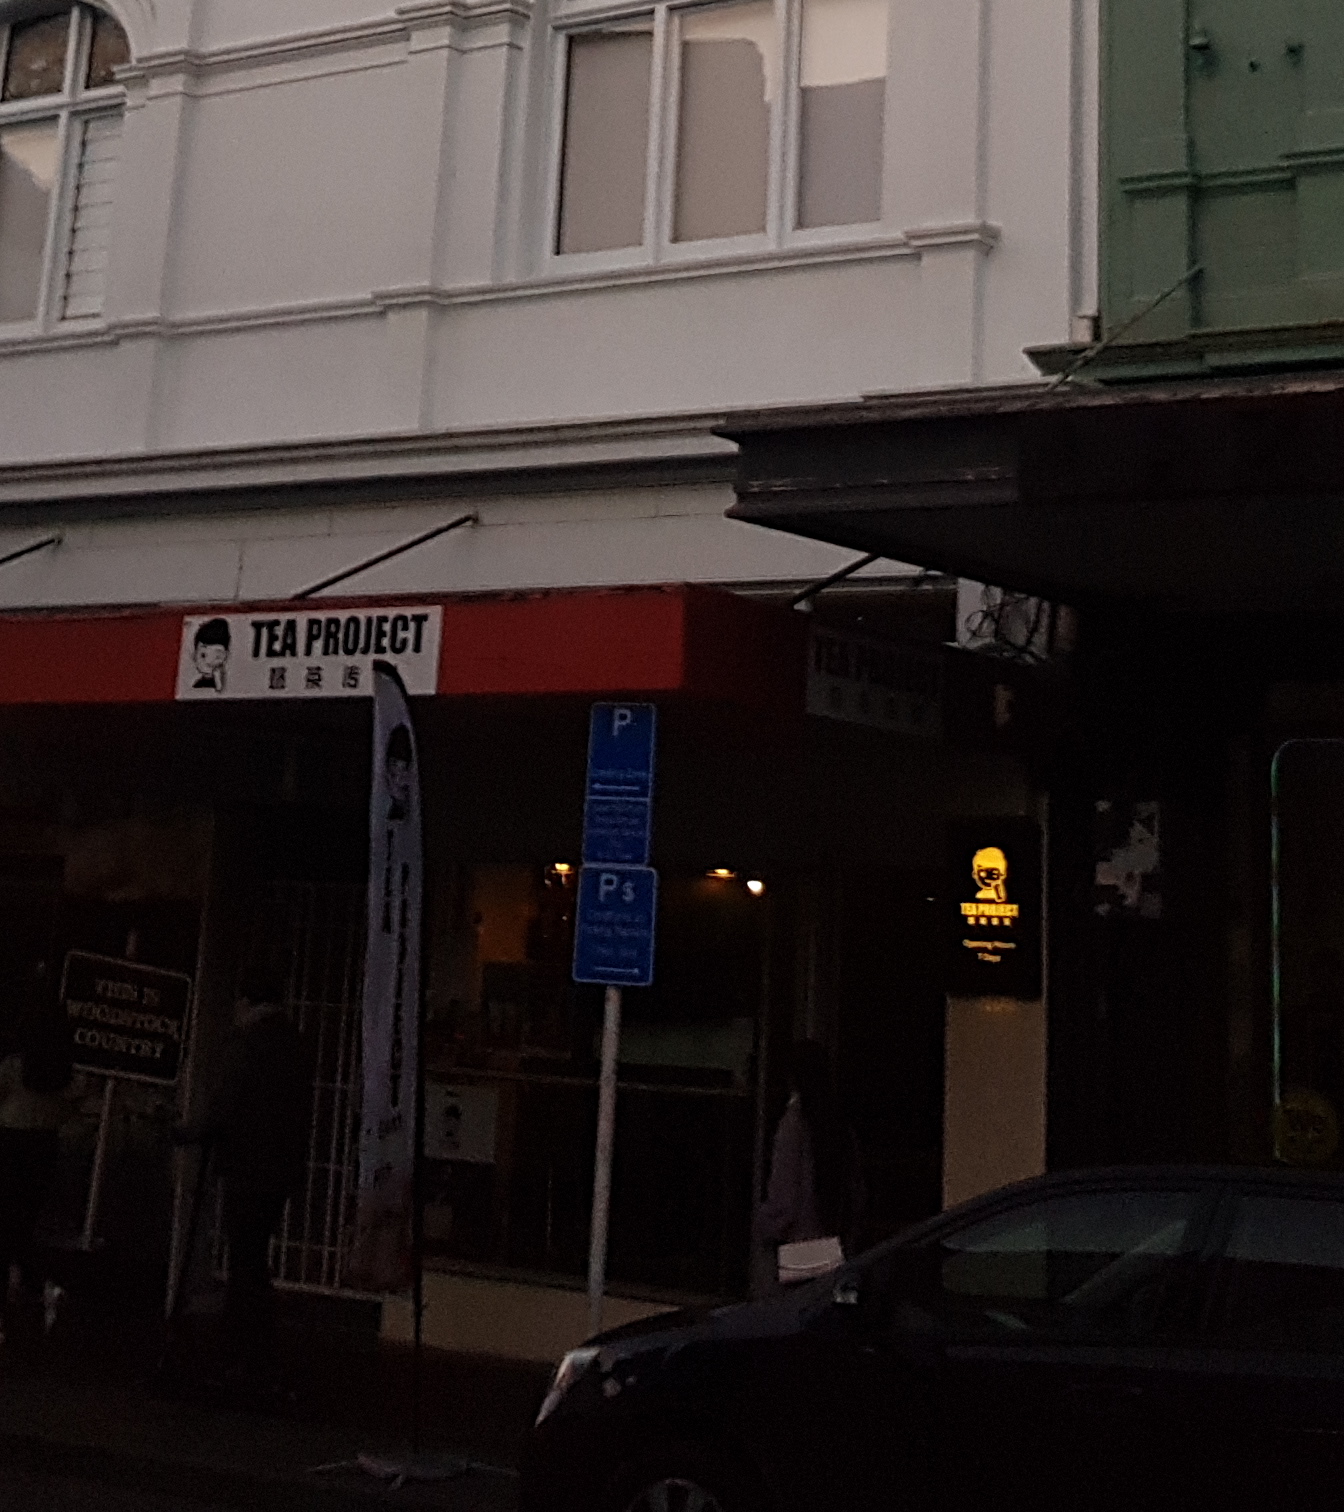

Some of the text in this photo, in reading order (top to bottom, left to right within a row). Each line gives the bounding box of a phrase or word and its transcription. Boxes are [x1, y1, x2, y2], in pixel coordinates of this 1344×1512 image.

[251, 615, 429, 658] TEA PROJECT
[612, 708, 632, 736] P
[73, 1027, 164, 1059] COUNTRY
